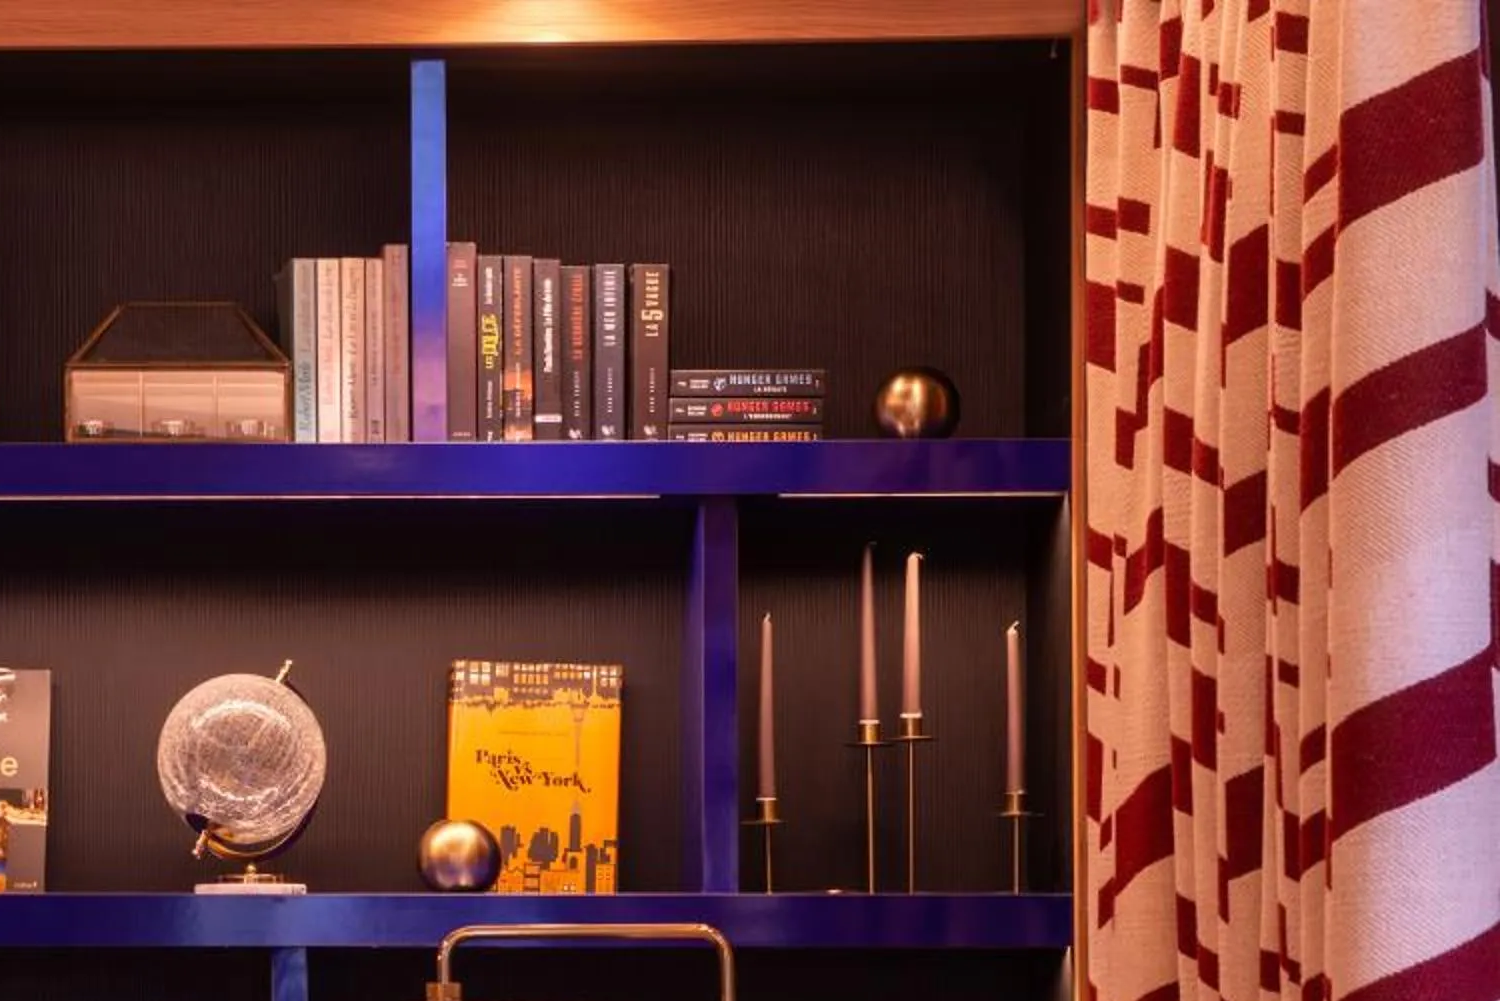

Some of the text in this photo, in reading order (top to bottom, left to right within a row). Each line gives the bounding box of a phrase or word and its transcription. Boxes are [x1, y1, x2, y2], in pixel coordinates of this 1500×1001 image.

[640, 271, 664, 337] LA 5 VAGUE
[603, 335, 617, 346] LA
[729, 374, 812, 385] HUNGER GAMES
[728, 401, 810, 412] HUNGER GAMES
[476, 749, 521, 768] Paris
[490, 770, 591, 793] New York
